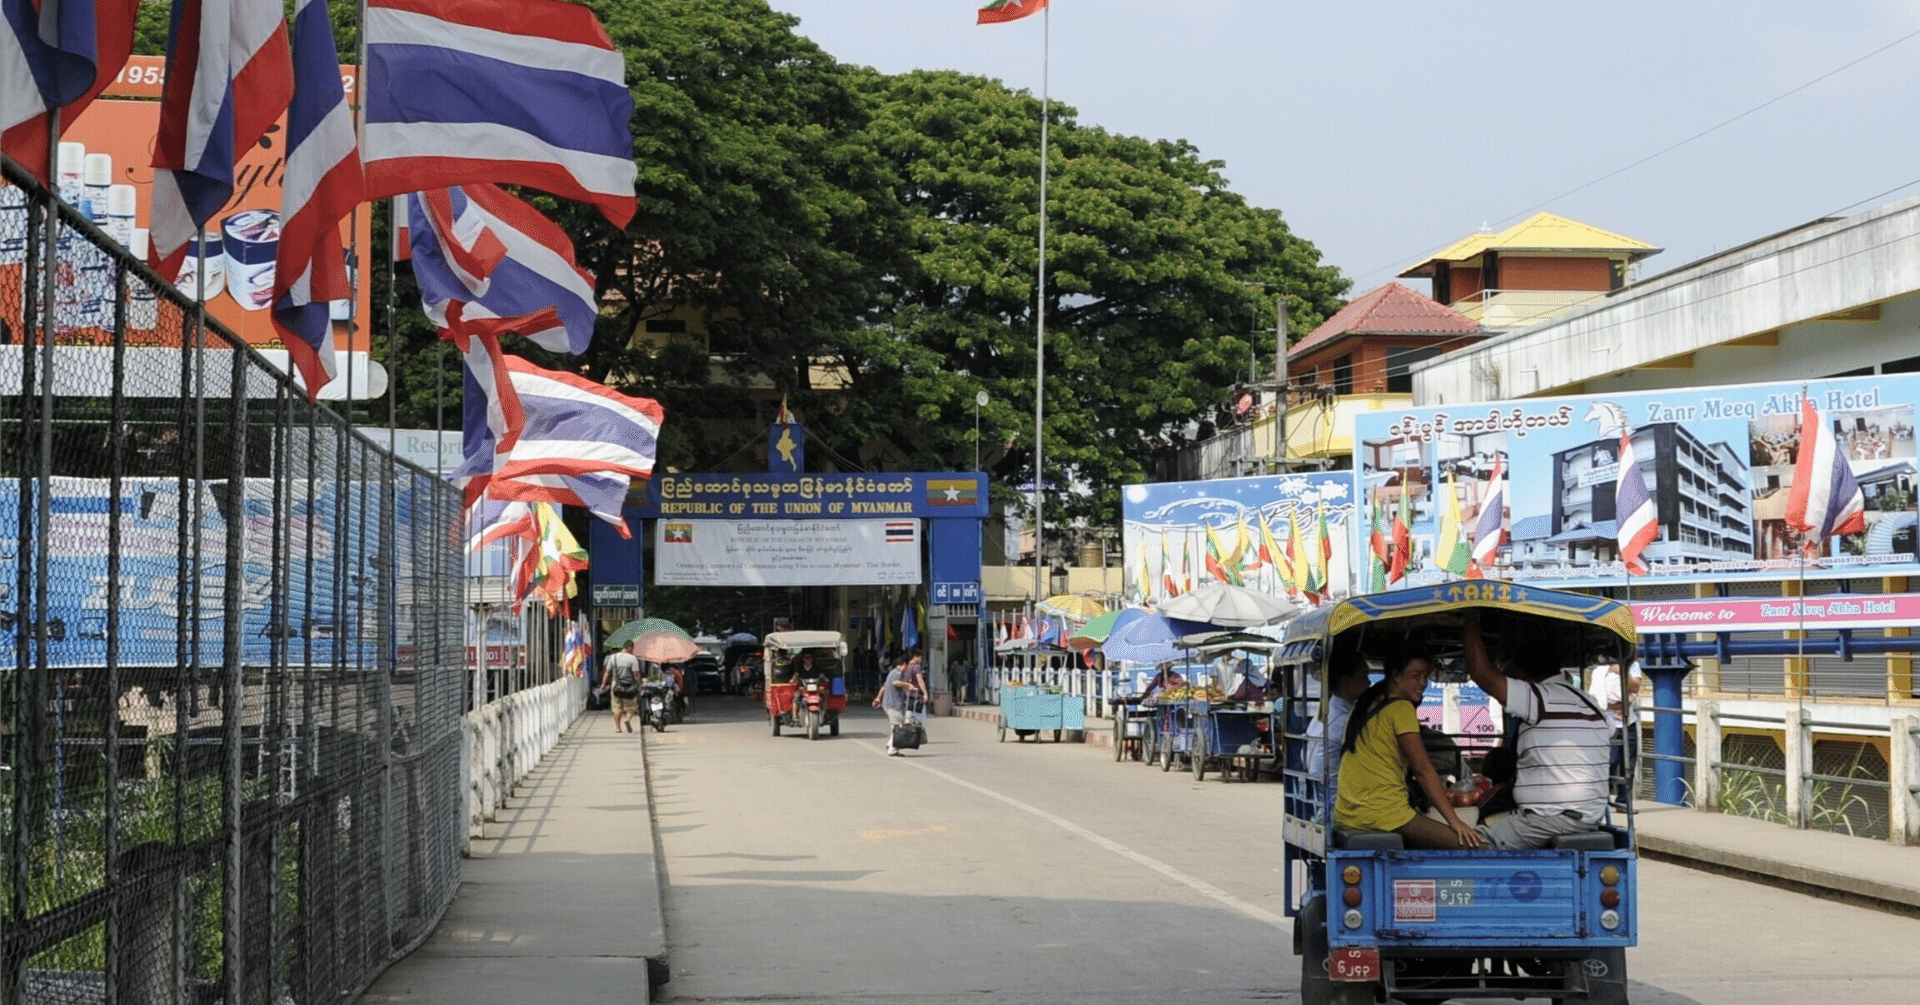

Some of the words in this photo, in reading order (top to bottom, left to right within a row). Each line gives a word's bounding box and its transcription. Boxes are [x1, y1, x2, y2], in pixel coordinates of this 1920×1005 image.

[1649, 403, 1695, 422] Zanr
[1703, 400, 1756, 420] Meeq
[1827, 388, 1879, 410] Hotel
[660, 502, 723, 514] REPUBLIC
[729, 502, 745, 514] OF
[752, 502, 778, 514] THE
[784, 502, 822, 514] UNION
[829, 502, 844, 514] OF
[852, 502, 913, 514] MYANMAR
[1448, 583, 1512, 602] TAXI
[1640, 606, 1715, 622] Welcome
[1717, 607, 1737, 620] to
[1864, 600, 1895, 614] Hotel
[1476, 724, 1495, 732] 100
